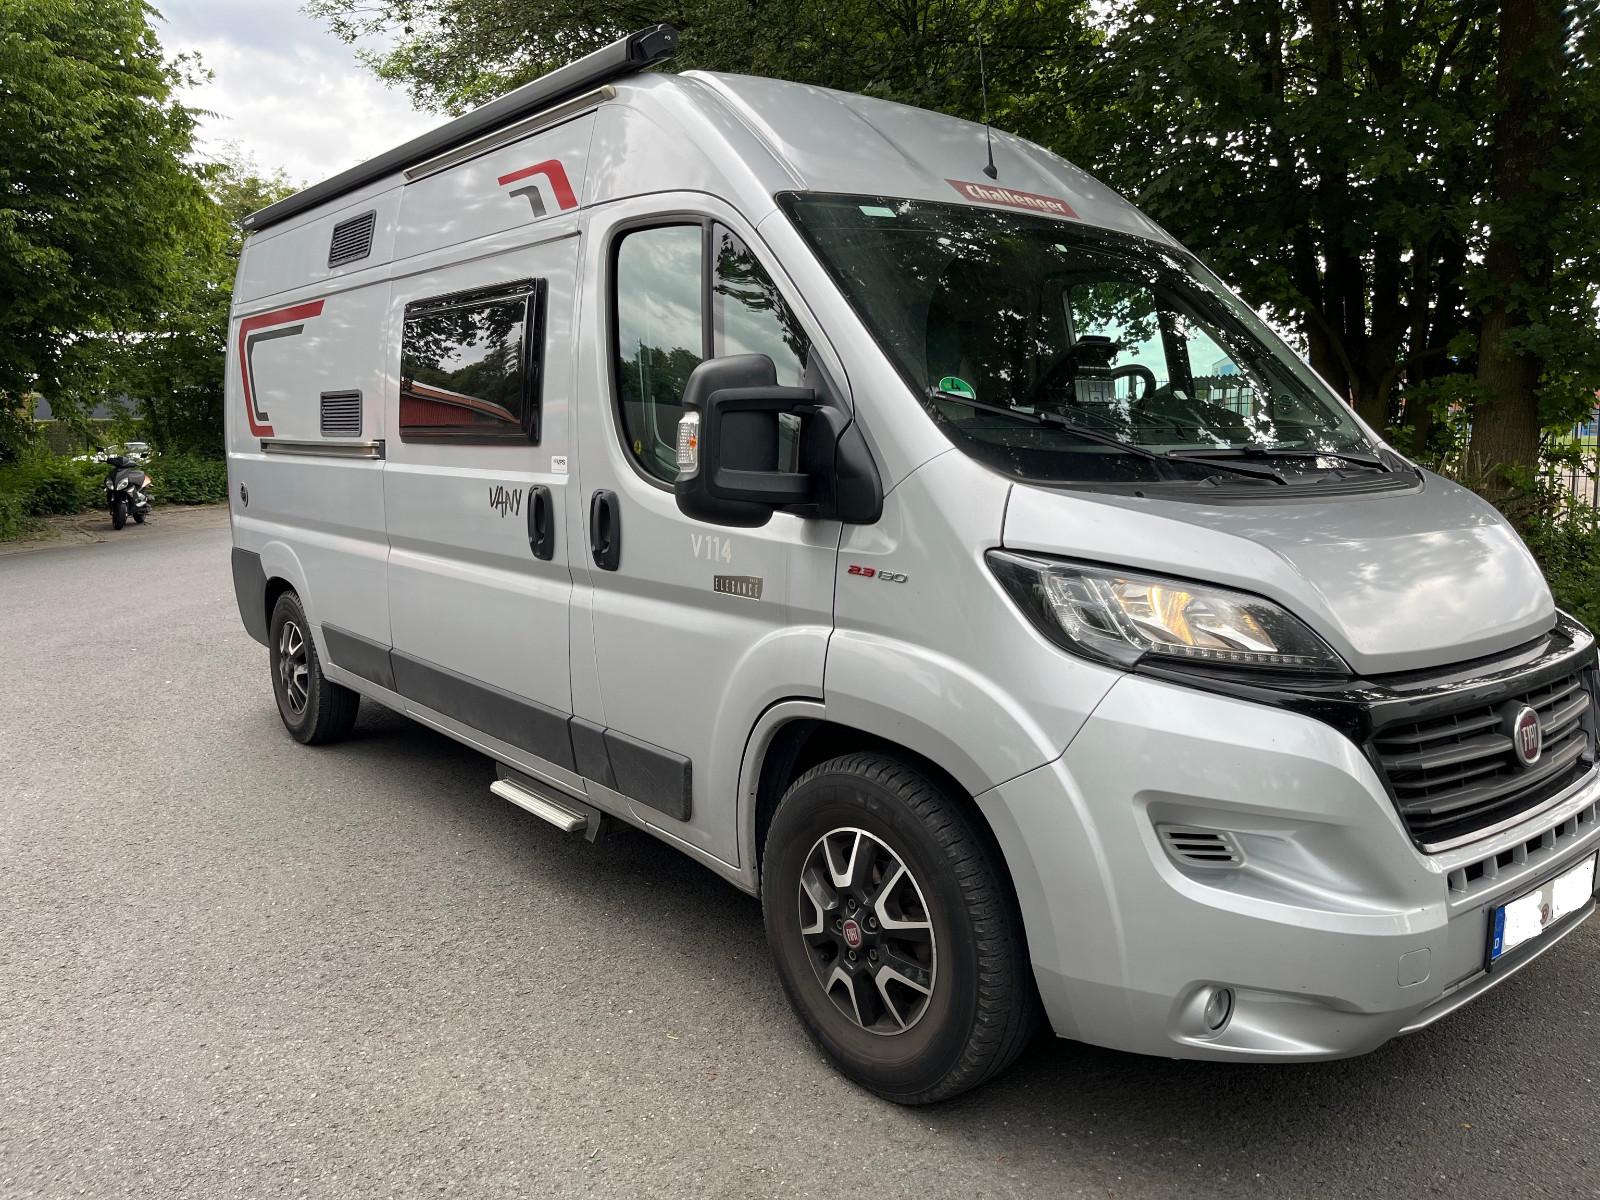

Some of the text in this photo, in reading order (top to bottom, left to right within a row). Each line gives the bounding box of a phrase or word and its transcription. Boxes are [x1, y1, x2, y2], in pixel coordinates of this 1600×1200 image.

[966, 184, 1066, 212] Challenger
[489, 485, 522, 518] VANY
[848, 565, 876, 578] 2.3
[715, 577, 758, 597] ELEGANCE
[1521, 723, 1537, 751] FIAT
[846, 928, 858, 942] FIAT
[1494, 937, 1500, 949] D
